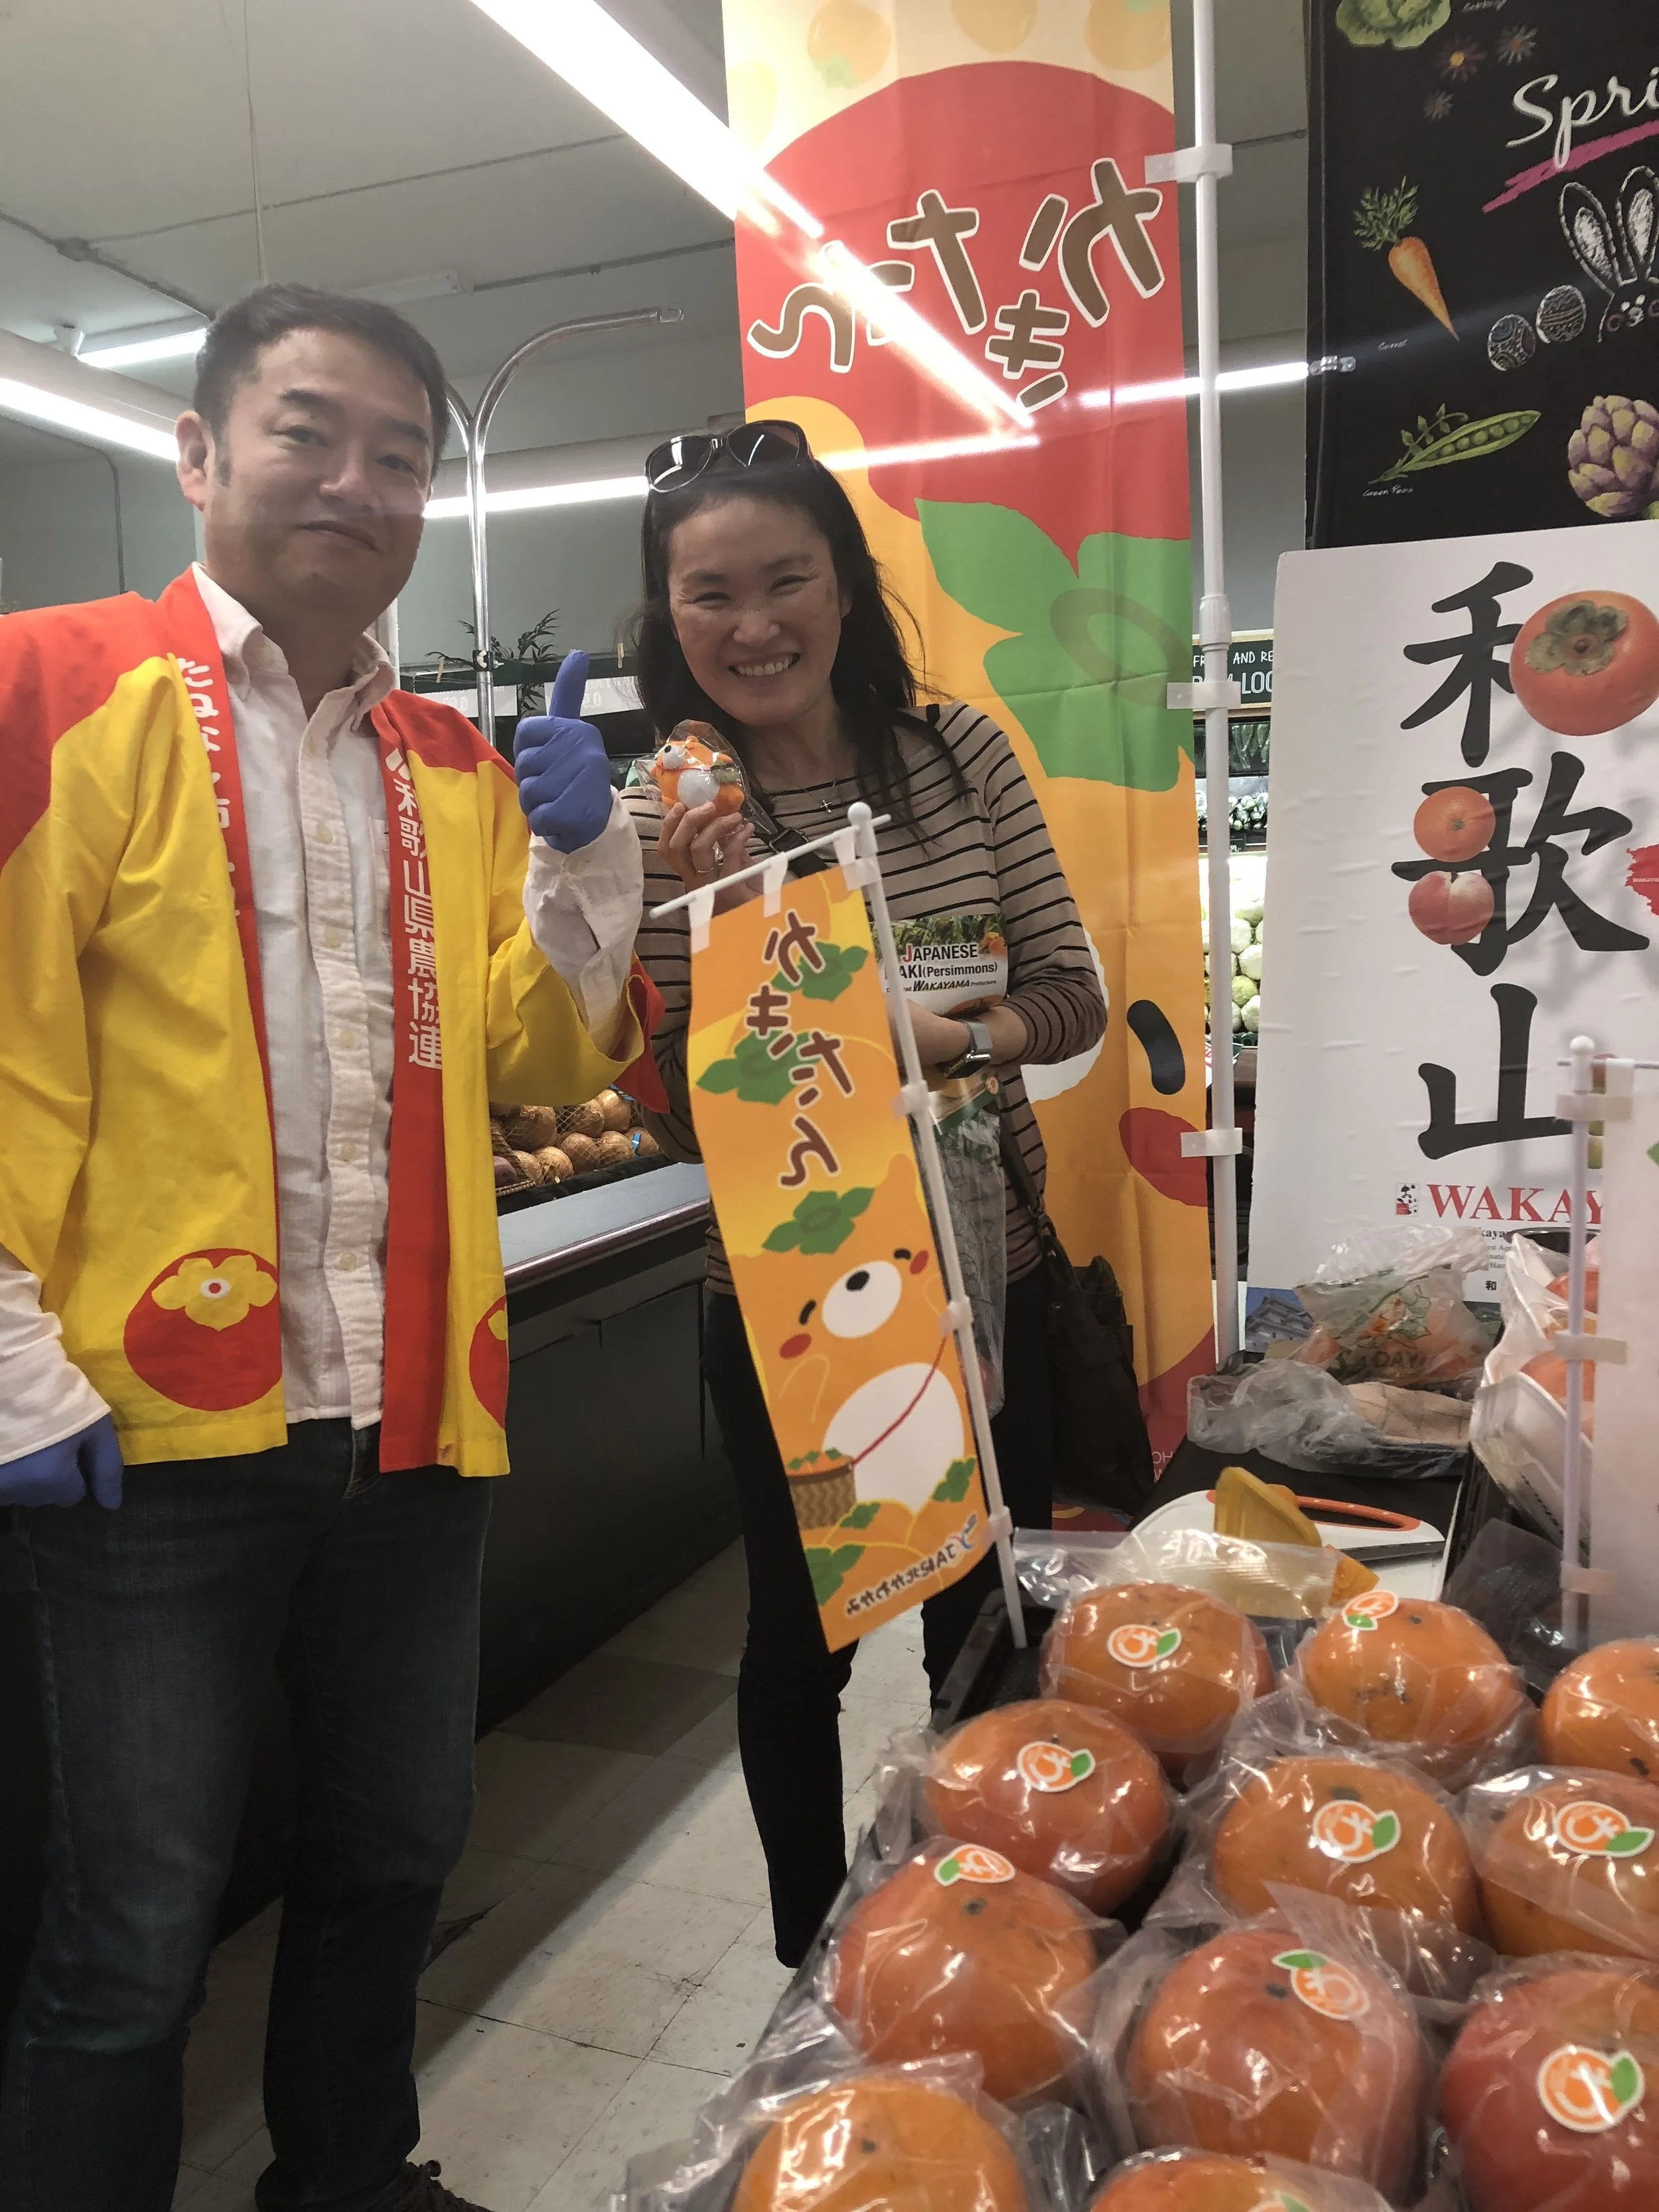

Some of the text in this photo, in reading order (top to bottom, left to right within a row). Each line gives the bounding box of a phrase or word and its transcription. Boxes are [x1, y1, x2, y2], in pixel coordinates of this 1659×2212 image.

[1506, 66, 1659, 171] Spri
[1232, 650, 1256, 665] AND
[902, 943, 978, 963] JAPANESE
[912, 979, 970, 992] WAKAYAMA
[1485, 1280, 1497, 1291] 和
